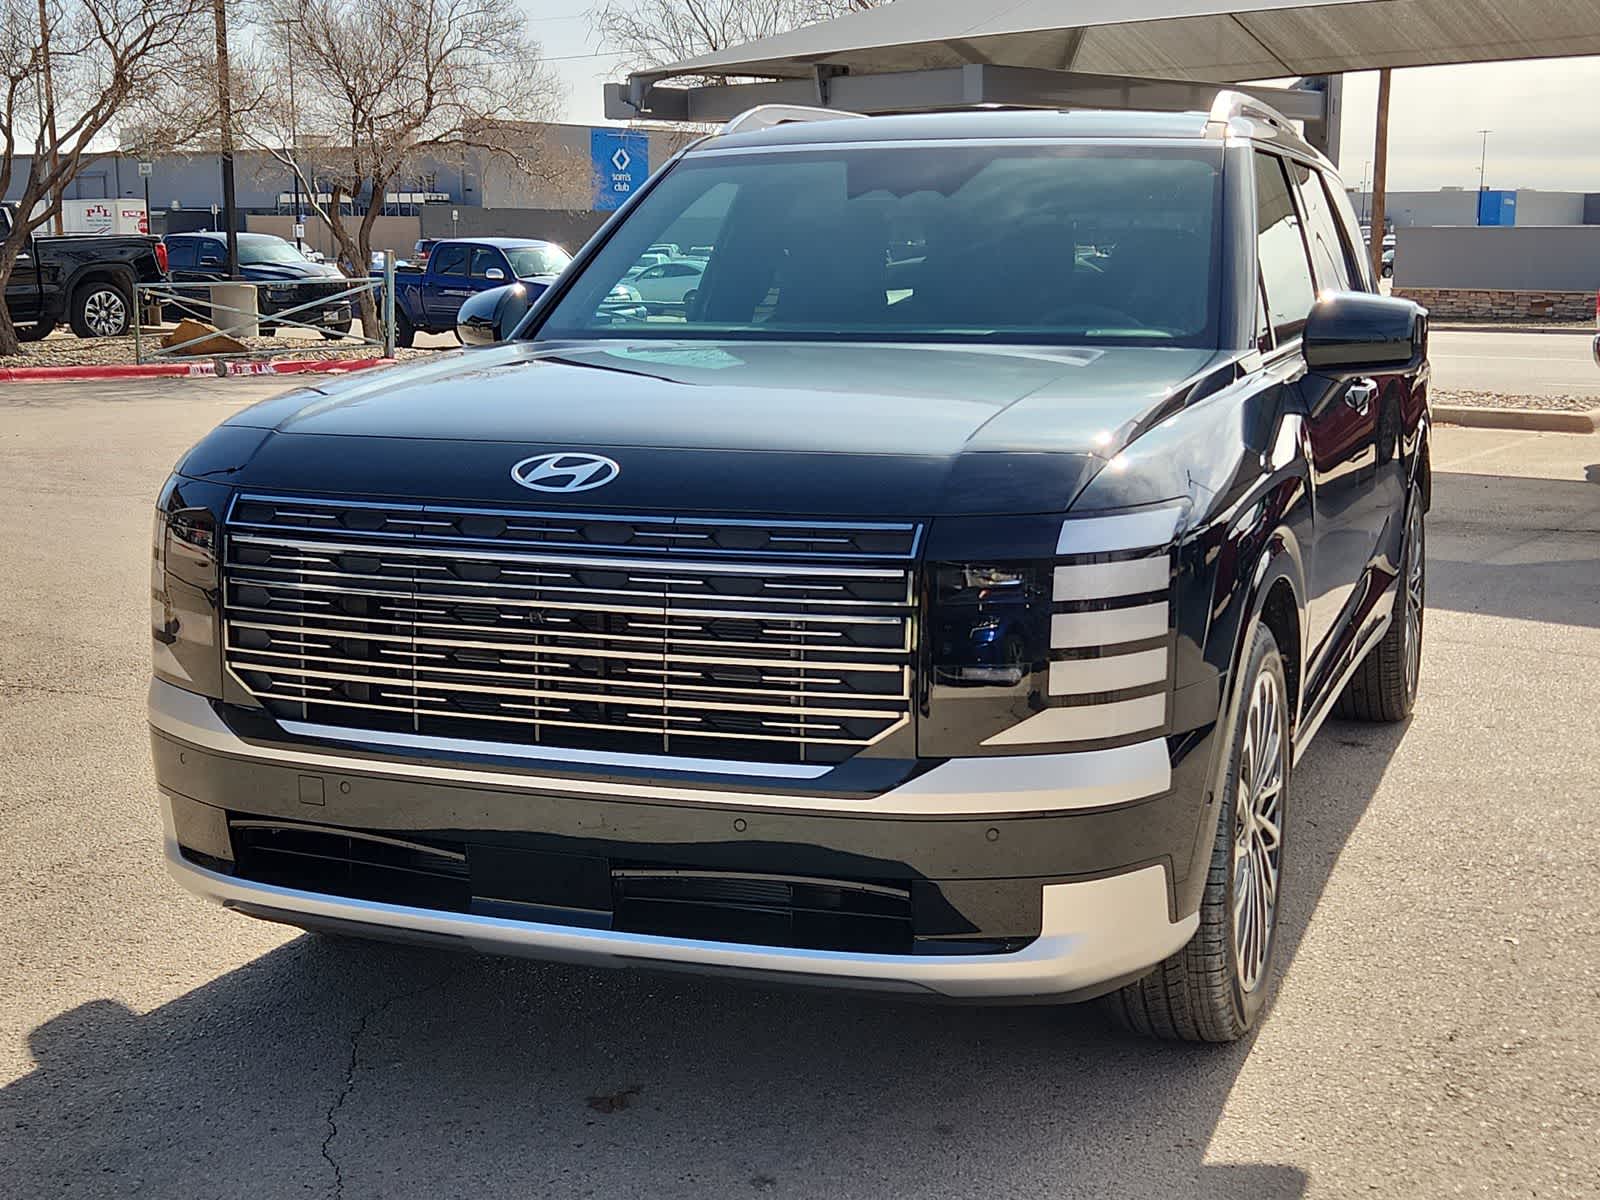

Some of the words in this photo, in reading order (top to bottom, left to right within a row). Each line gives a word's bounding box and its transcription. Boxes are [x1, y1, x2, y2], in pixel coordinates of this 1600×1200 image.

[611, 173, 632, 182] sam's
[614, 182, 630, 192] club
[86, 204, 112, 218] PTL
